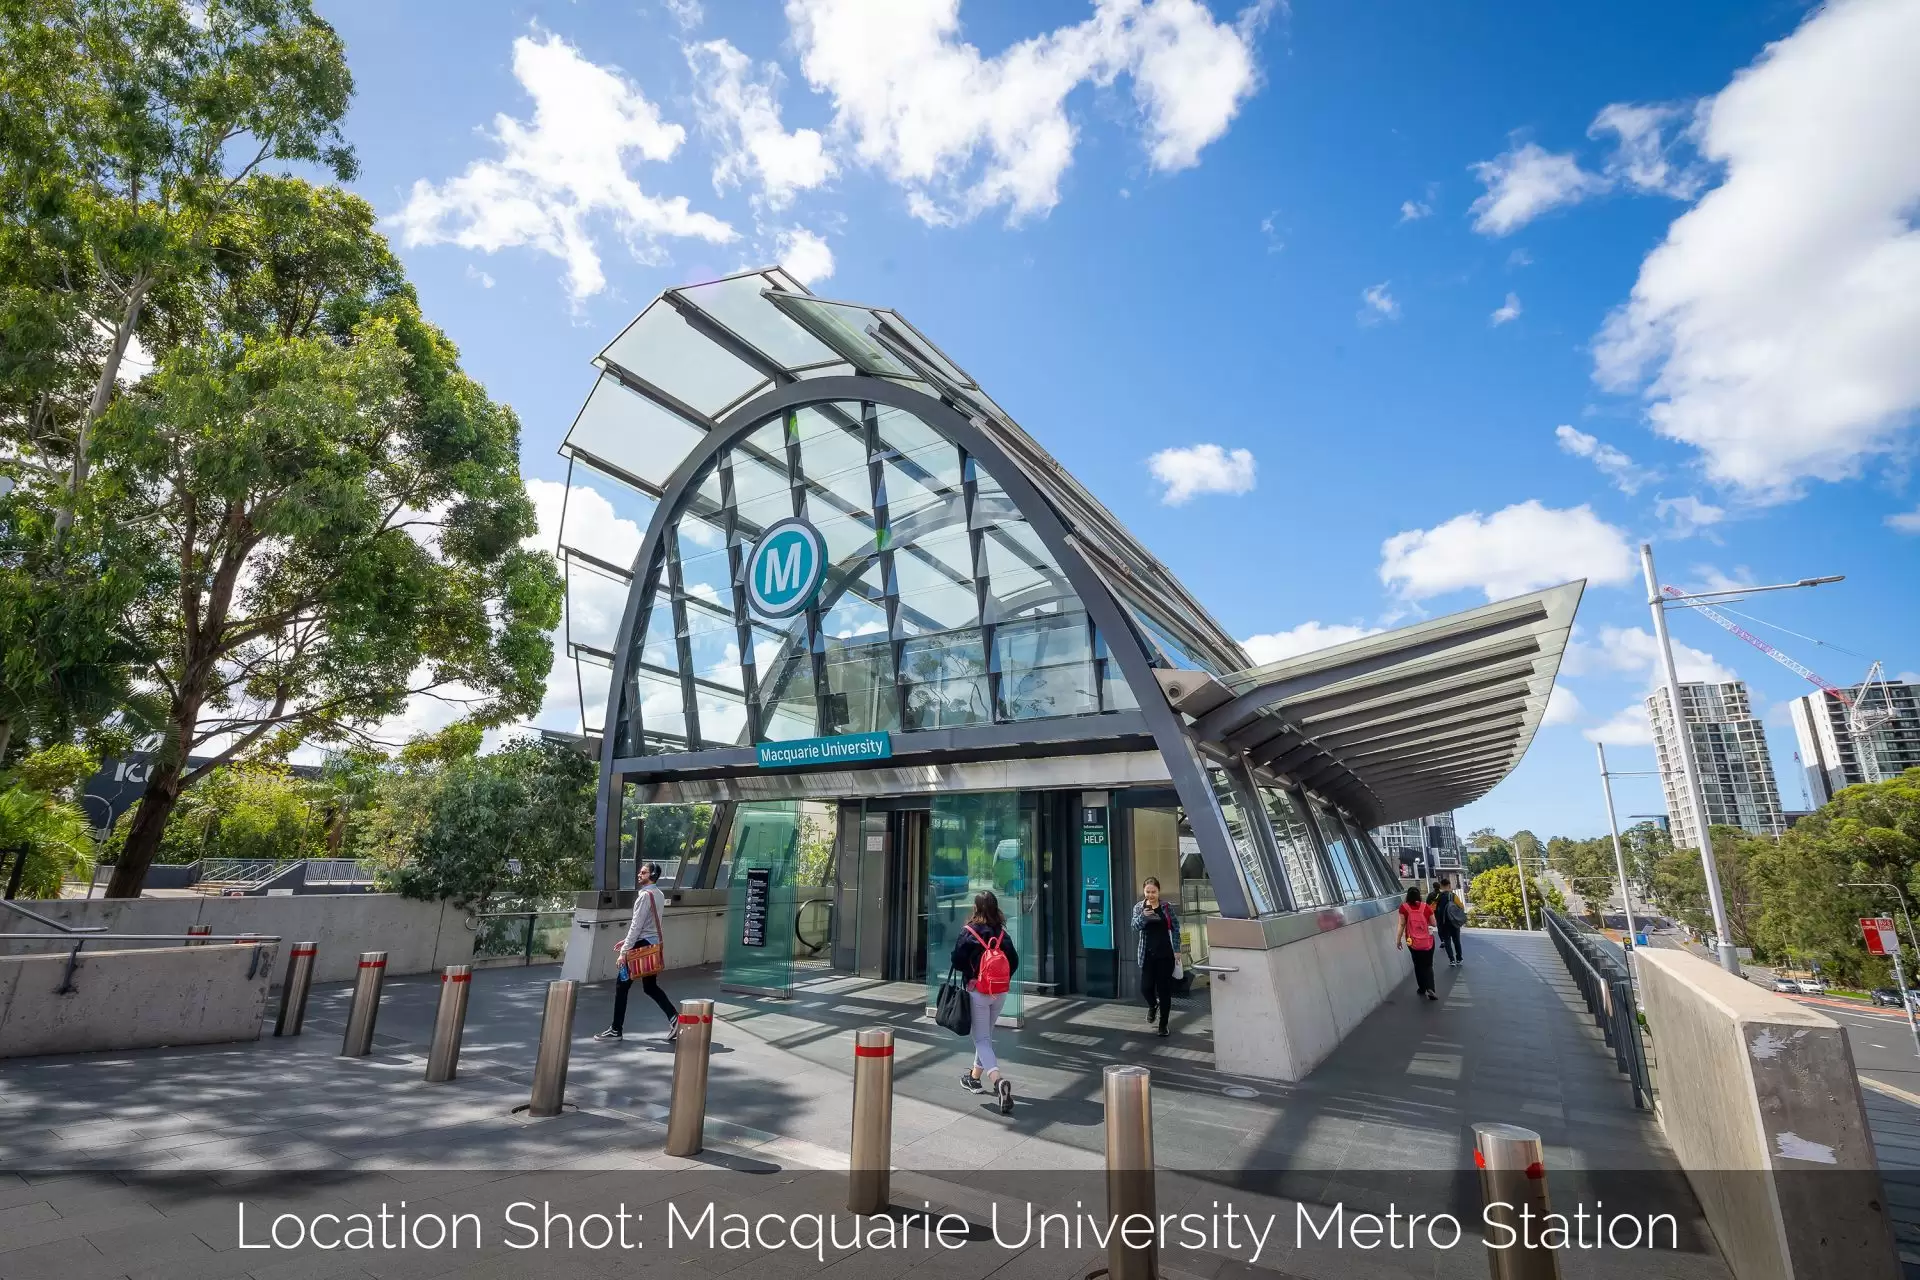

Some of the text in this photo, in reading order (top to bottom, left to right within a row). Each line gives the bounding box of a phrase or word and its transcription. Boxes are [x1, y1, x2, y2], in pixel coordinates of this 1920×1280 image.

[764, 541, 802, 595] M
[761, 739, 883, 763] Macquarie University
[1084, 835, 1104, 844] HELP
